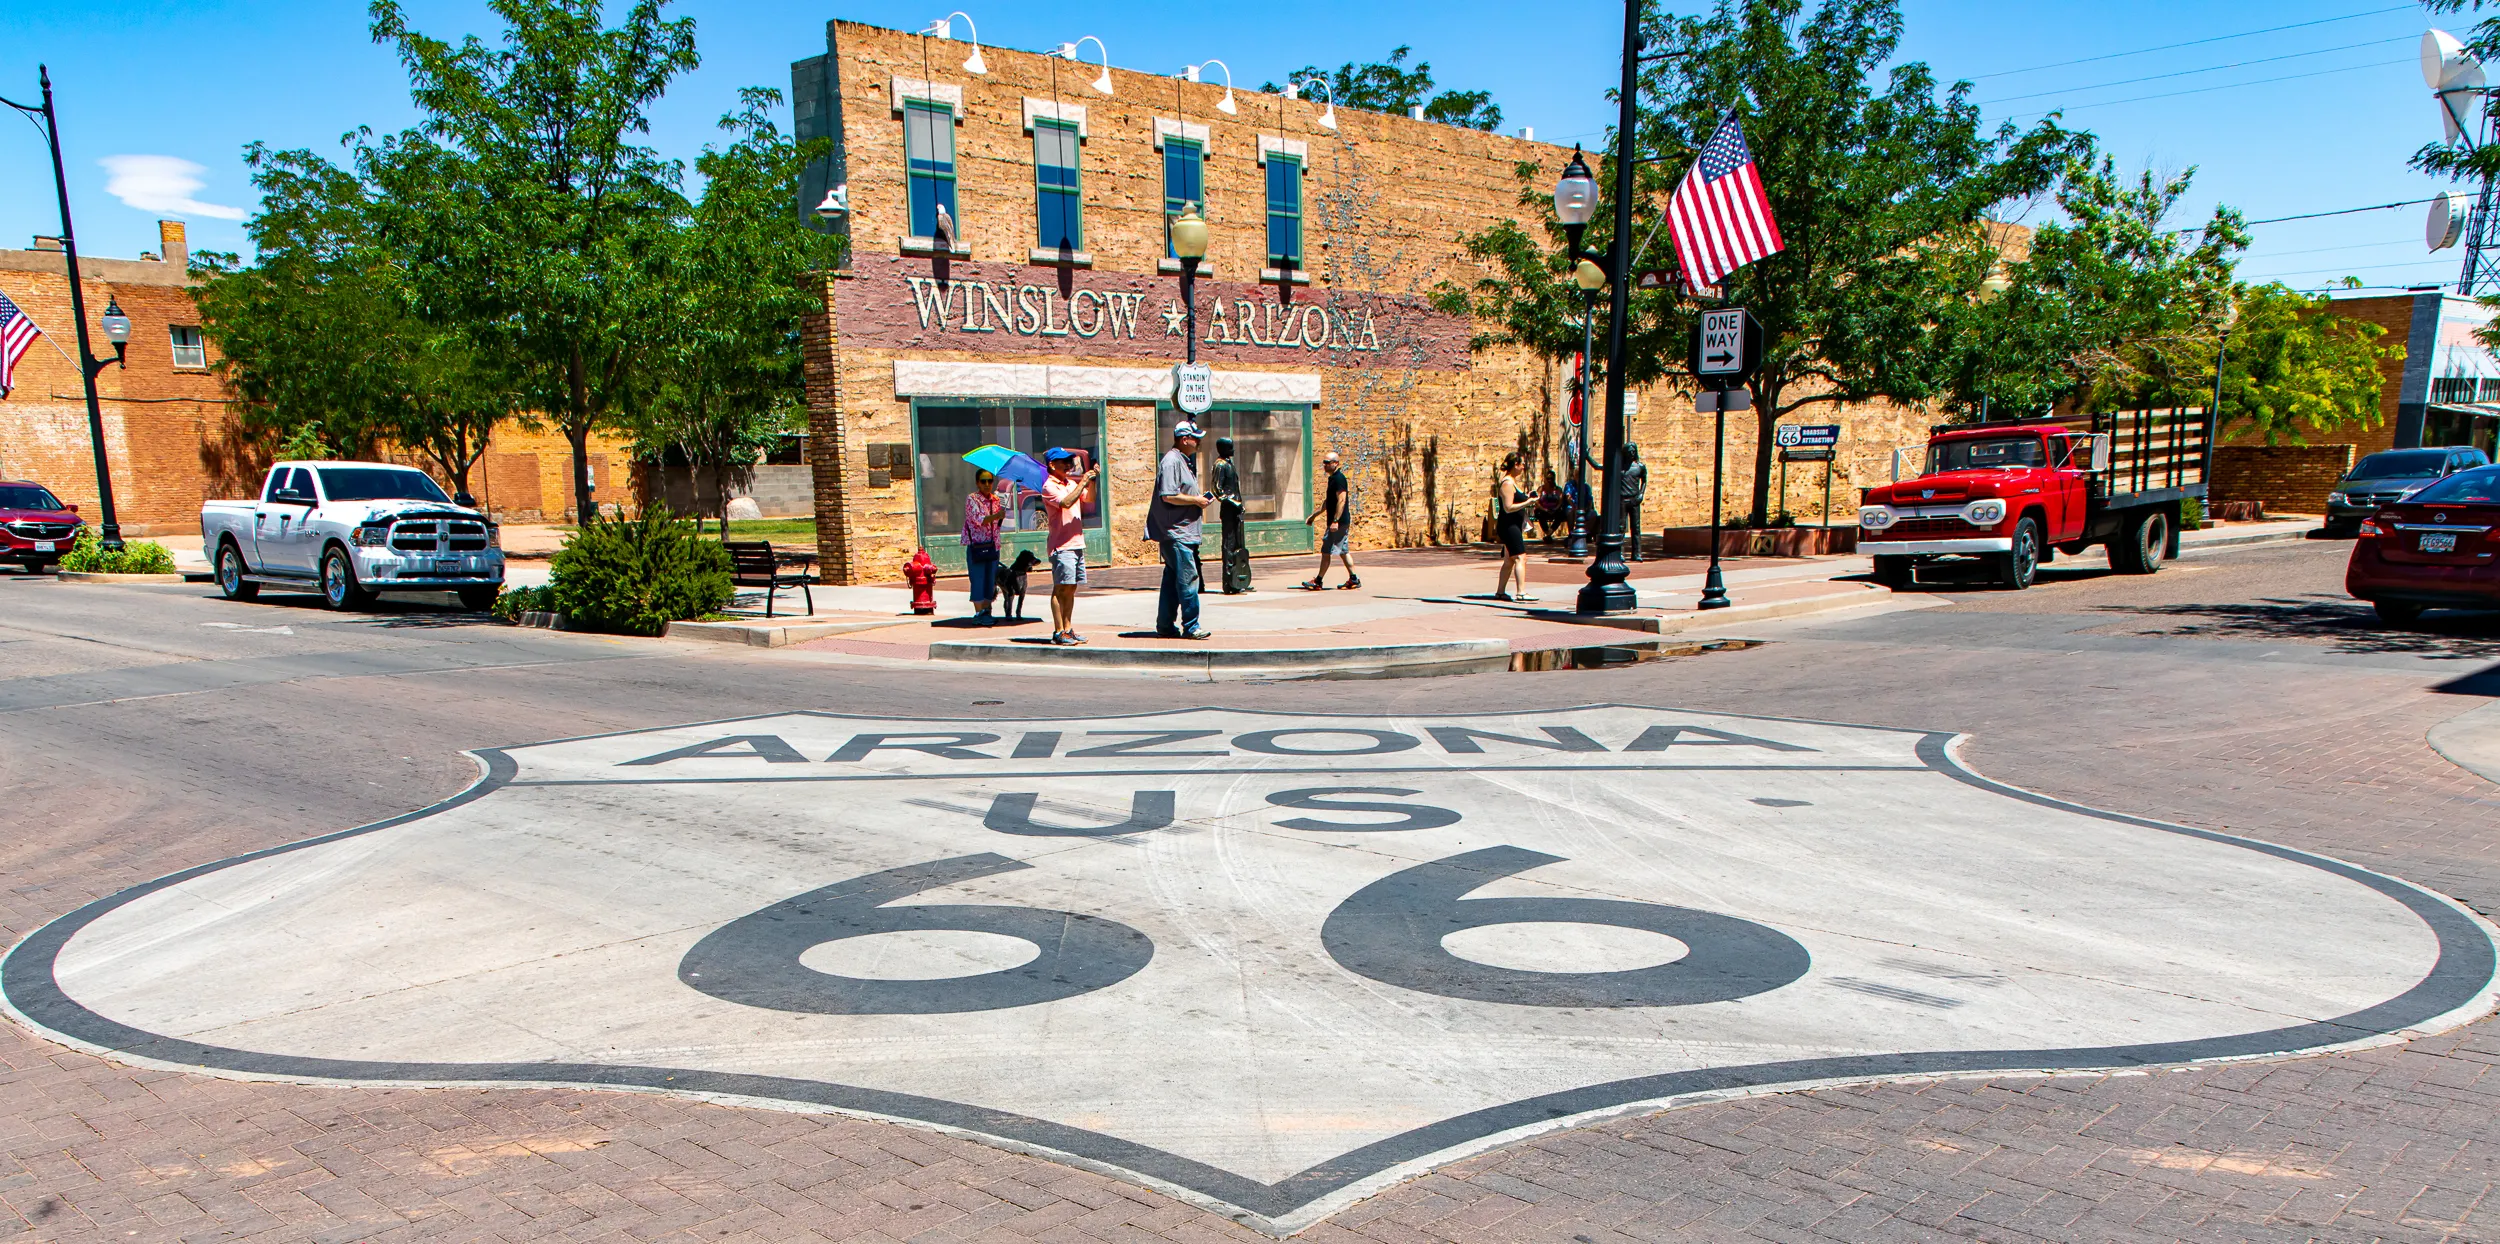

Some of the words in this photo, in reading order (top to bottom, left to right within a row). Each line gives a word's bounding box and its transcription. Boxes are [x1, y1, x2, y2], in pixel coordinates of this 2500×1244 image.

[906, 275, 1146, 340] WINSLOW
[1203, 295, 1380, 352] ARIZONA
[1707, 314, 1738, 331] ONE
[1706, 332, 1738, 348] WAY
[1183, 373, 1208, 382] STANDIN'
[1186, 384, 1194, 393] ON
[1195, 384, 1205, 393] THE
[1185, 394, 1206, 403] CORNER
[1781, 432, 1798, 444] 66
[1802, 428, 1829, 436] ROADSIDE
[1802, 436, 1835, 444] ATTRACTION
[616, 725, 1821, 767] ARIZONA
[677, 842, 1812, 1016] 66
